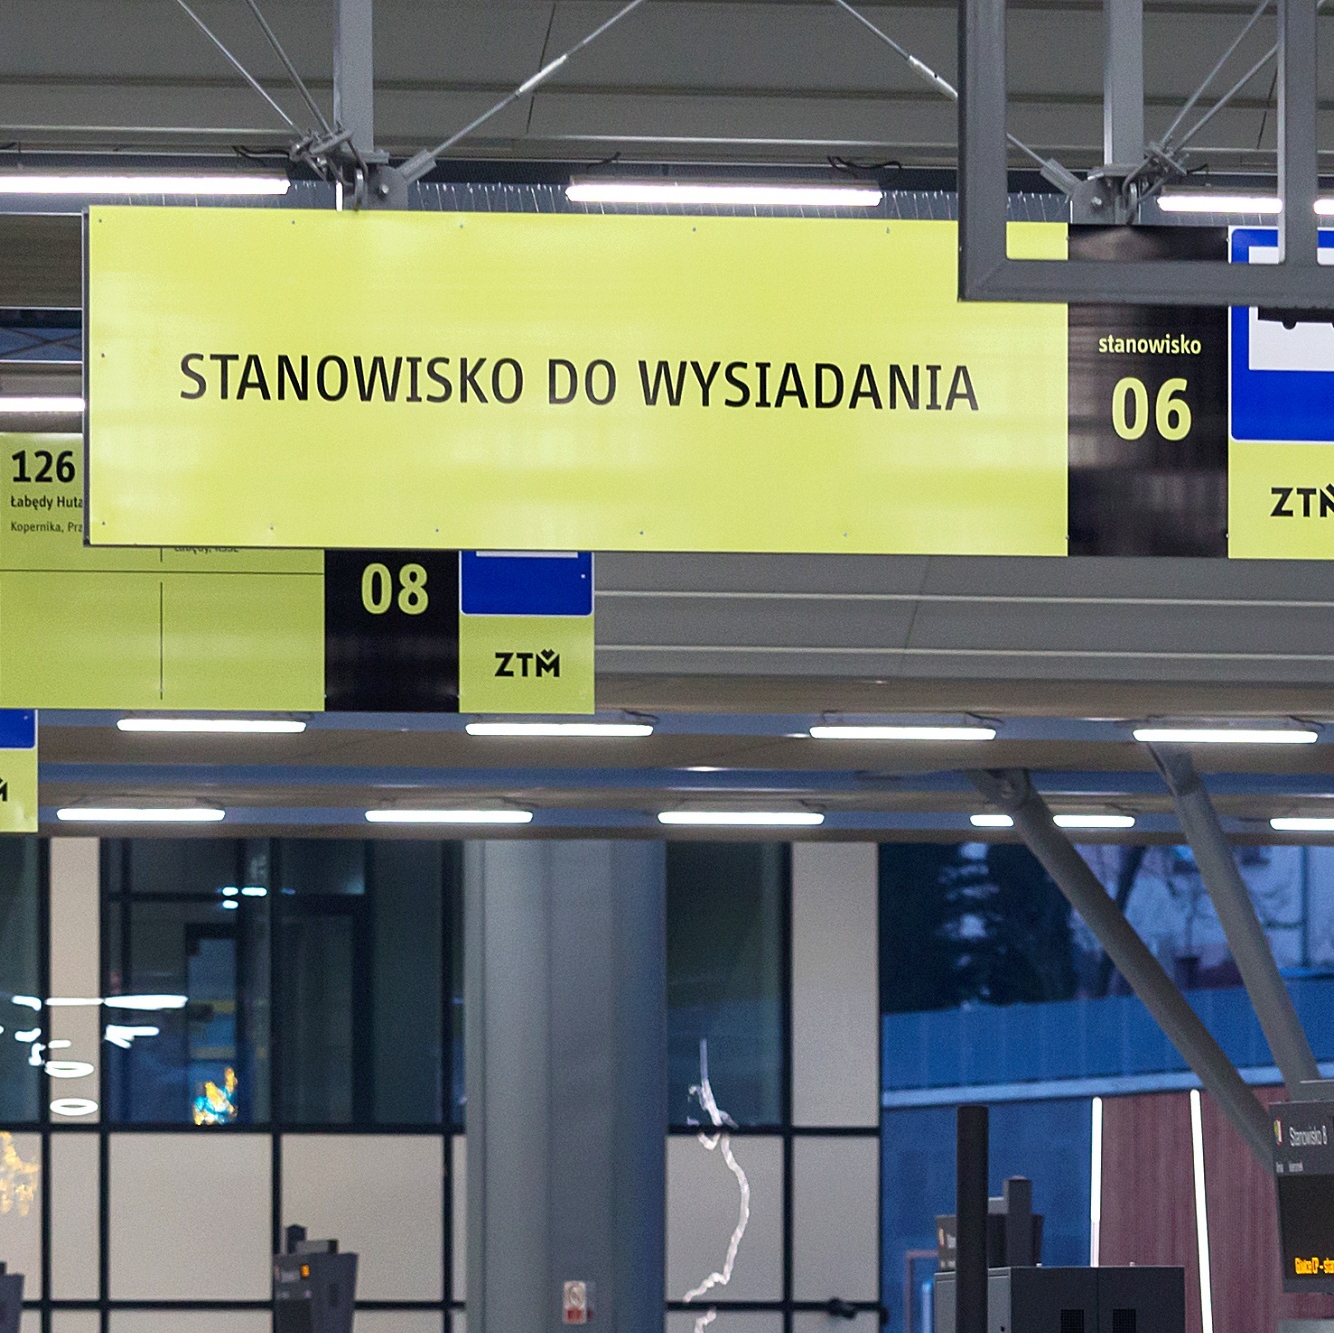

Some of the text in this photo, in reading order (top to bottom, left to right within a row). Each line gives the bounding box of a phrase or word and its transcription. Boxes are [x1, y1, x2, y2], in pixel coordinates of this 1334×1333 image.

[1098, 332, 1203, 357] stanowisko
[179, 351, 980, 413] STANOWISKO DO WYSIADANIA
[1111, 376, 1193, 442] 06
[11, 450, 76, 483] 126
[10, 495, 53, 510] Łabędy
[10, 521, 65, 534] Kopernika,
[360, 562, 429, 616] 08
[493, 649, 561, 678] ZTM
